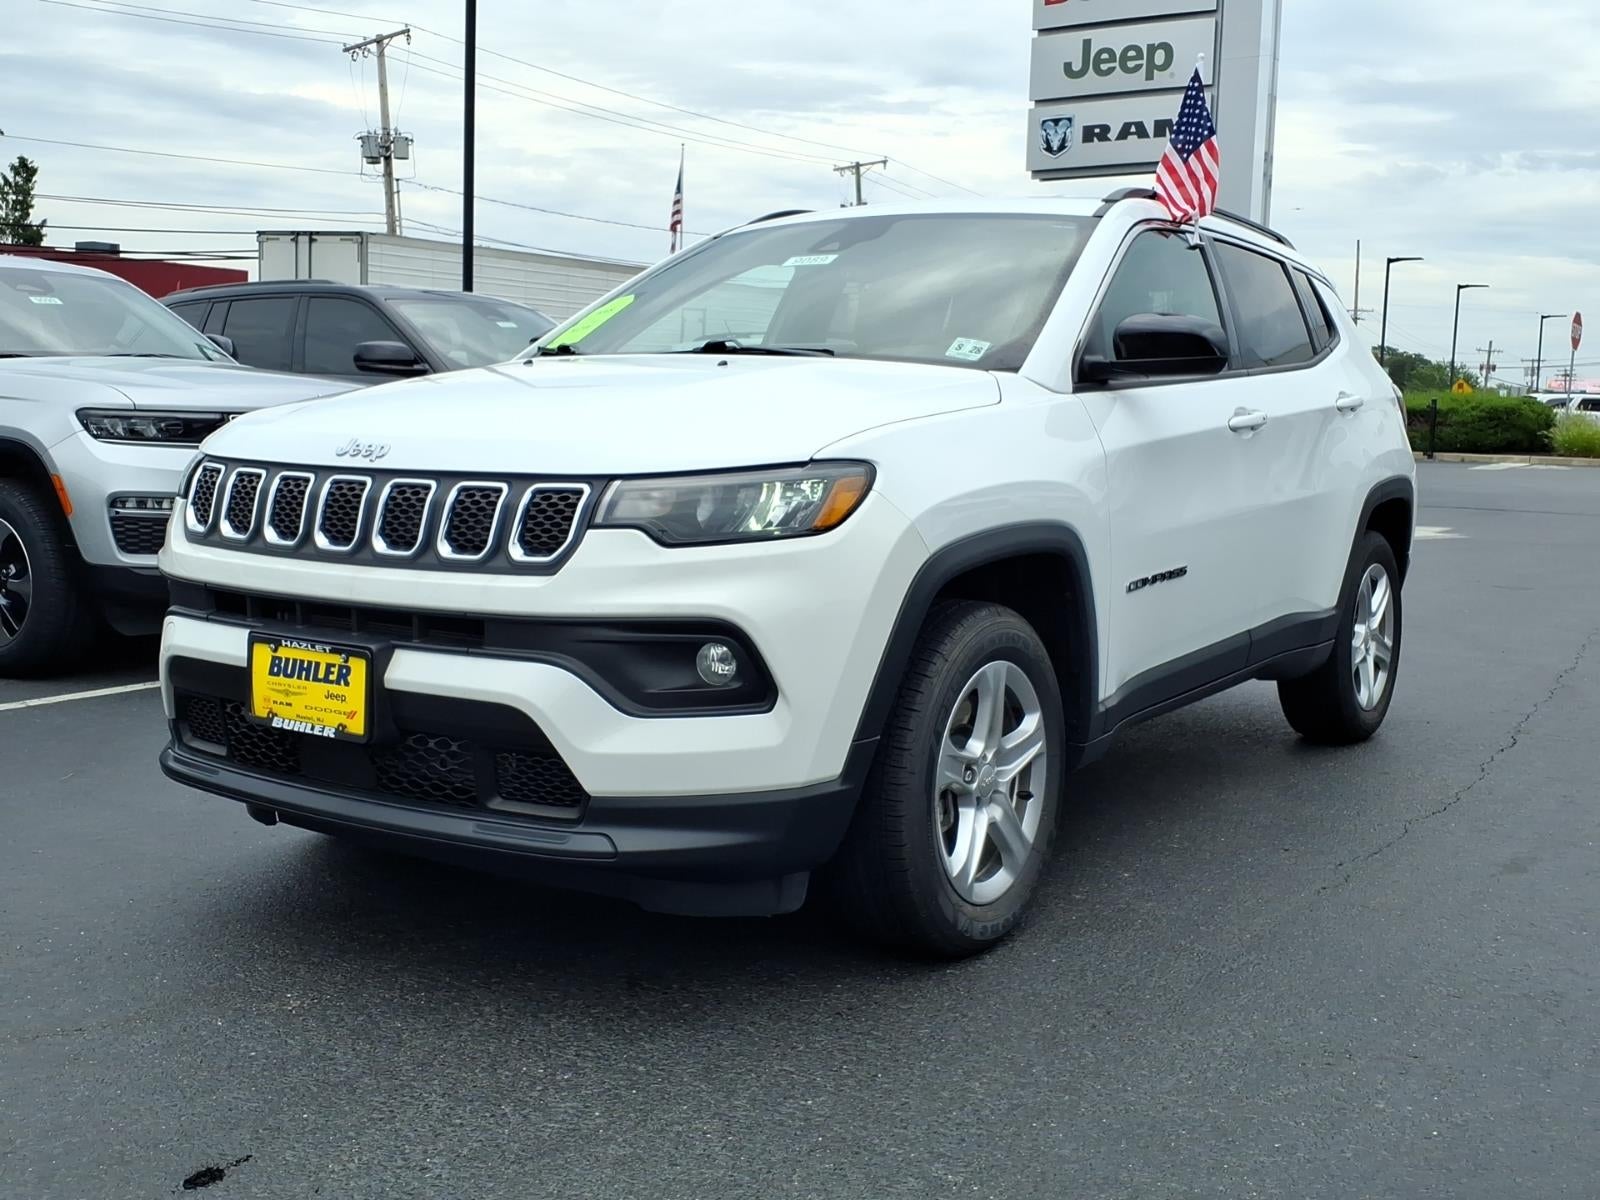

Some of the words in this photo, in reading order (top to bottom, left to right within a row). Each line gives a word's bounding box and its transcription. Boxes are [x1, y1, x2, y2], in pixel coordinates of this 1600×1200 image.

[1063, 38, 1174, 81] Jeep
[336, 438, 391, 462] Jeep
[1126, 565, 1188, 594] COMPASS
[281, 640, 331, 653] HAZLET
[268, 655, 351, 687] BUHLER
[266, 681, 307, 690] CHRYSLER
[324, 690, 347, 703] Jeep
[304, 705, 349, 716] DODGE
[271, 716, 336, 738] BUHLER
